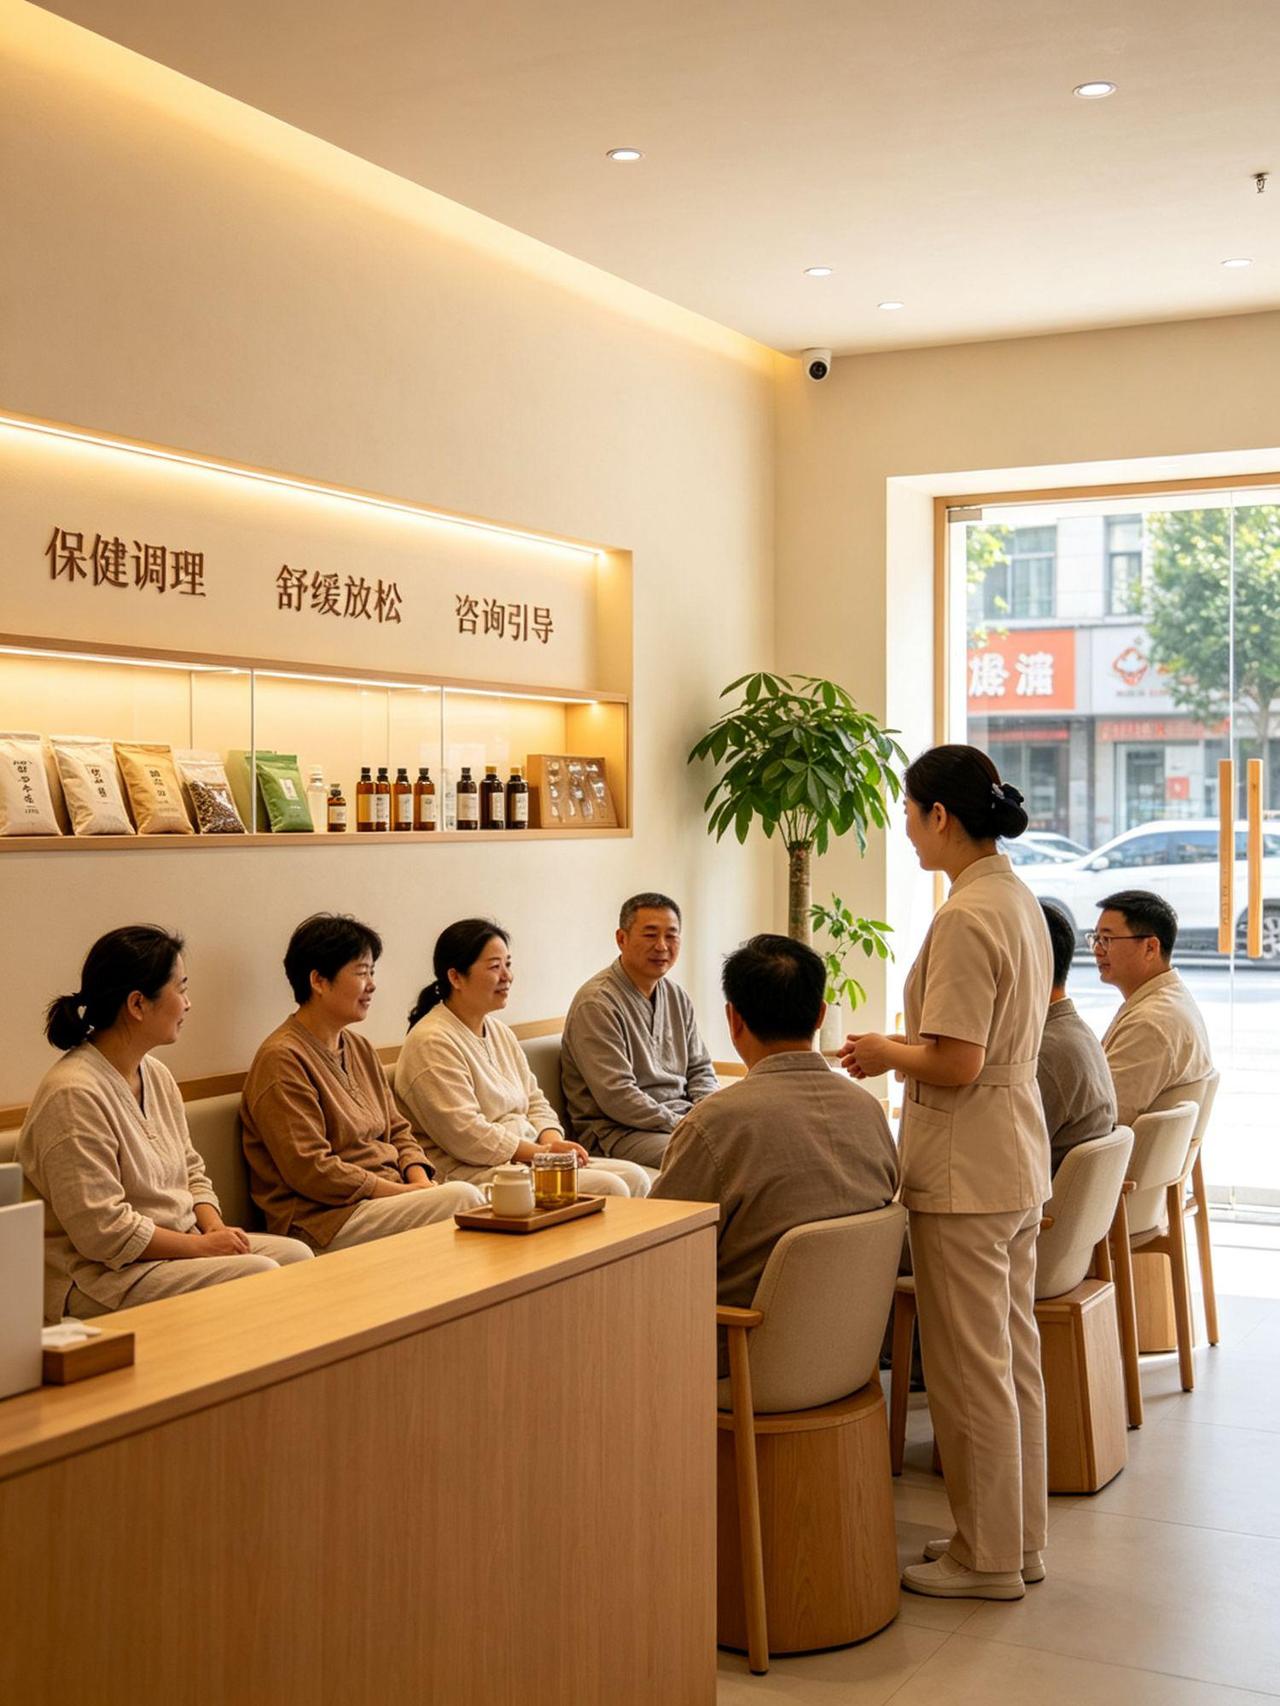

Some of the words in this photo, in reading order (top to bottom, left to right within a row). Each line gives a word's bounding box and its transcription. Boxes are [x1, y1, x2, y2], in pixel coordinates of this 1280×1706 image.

[45, 526, 206, 597] 保健调理
[276, 564, 402, 624] 舒缓放松
[455, 594, 554, 644] 咨询引导
